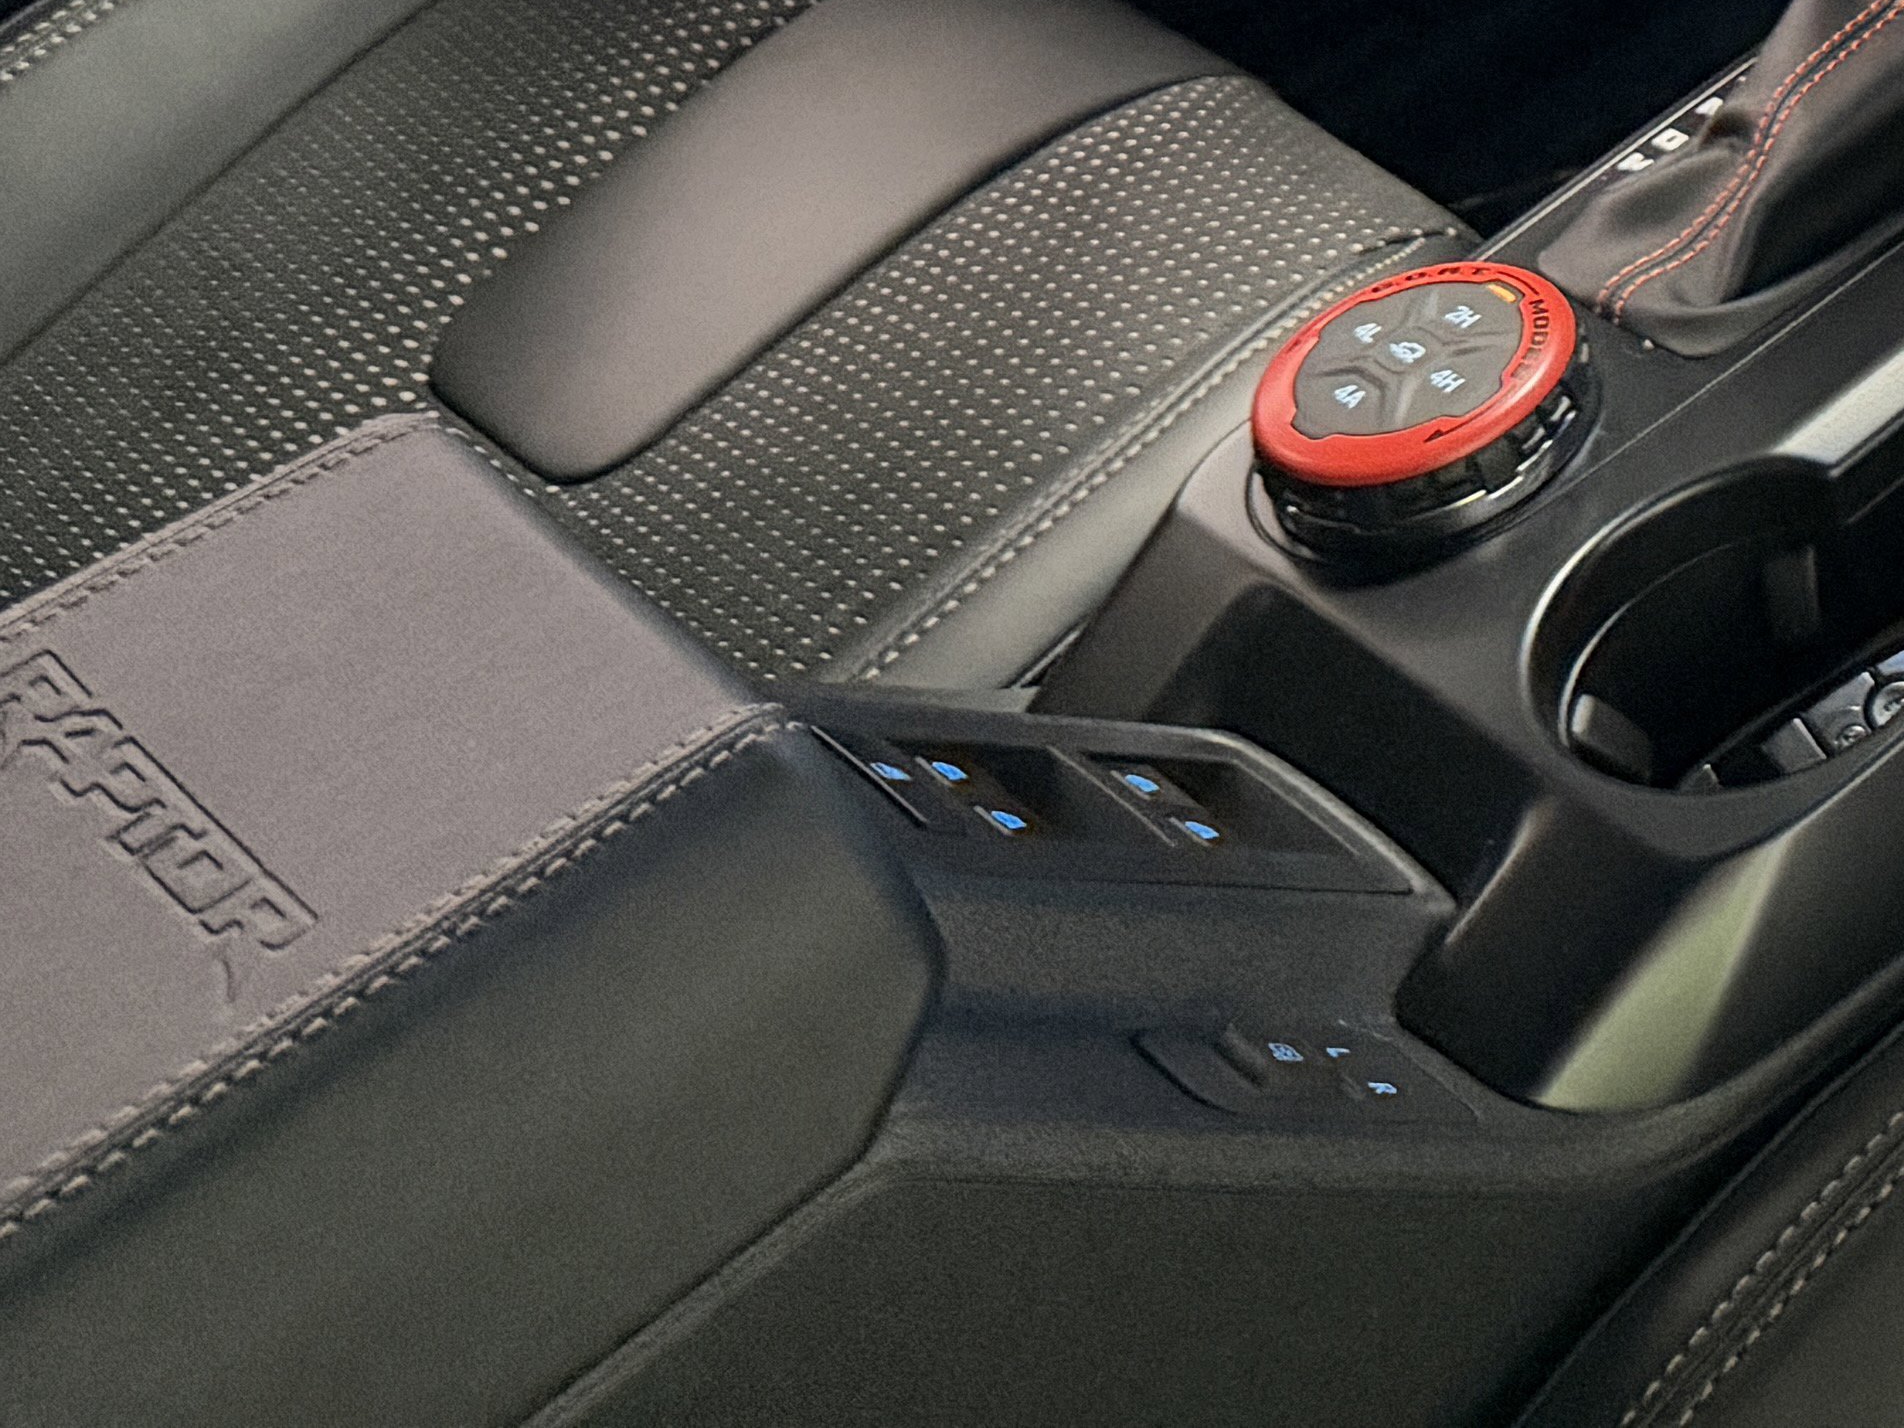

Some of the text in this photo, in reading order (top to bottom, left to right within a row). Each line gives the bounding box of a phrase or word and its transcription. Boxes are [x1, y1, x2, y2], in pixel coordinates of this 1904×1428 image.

[1444, 305, 1483, 329] 2H
[1353, 322, 1382, 344] 4L
[1429, 369, 1466, 393] 4H
[1334, 384, 1366, 409] 4A
